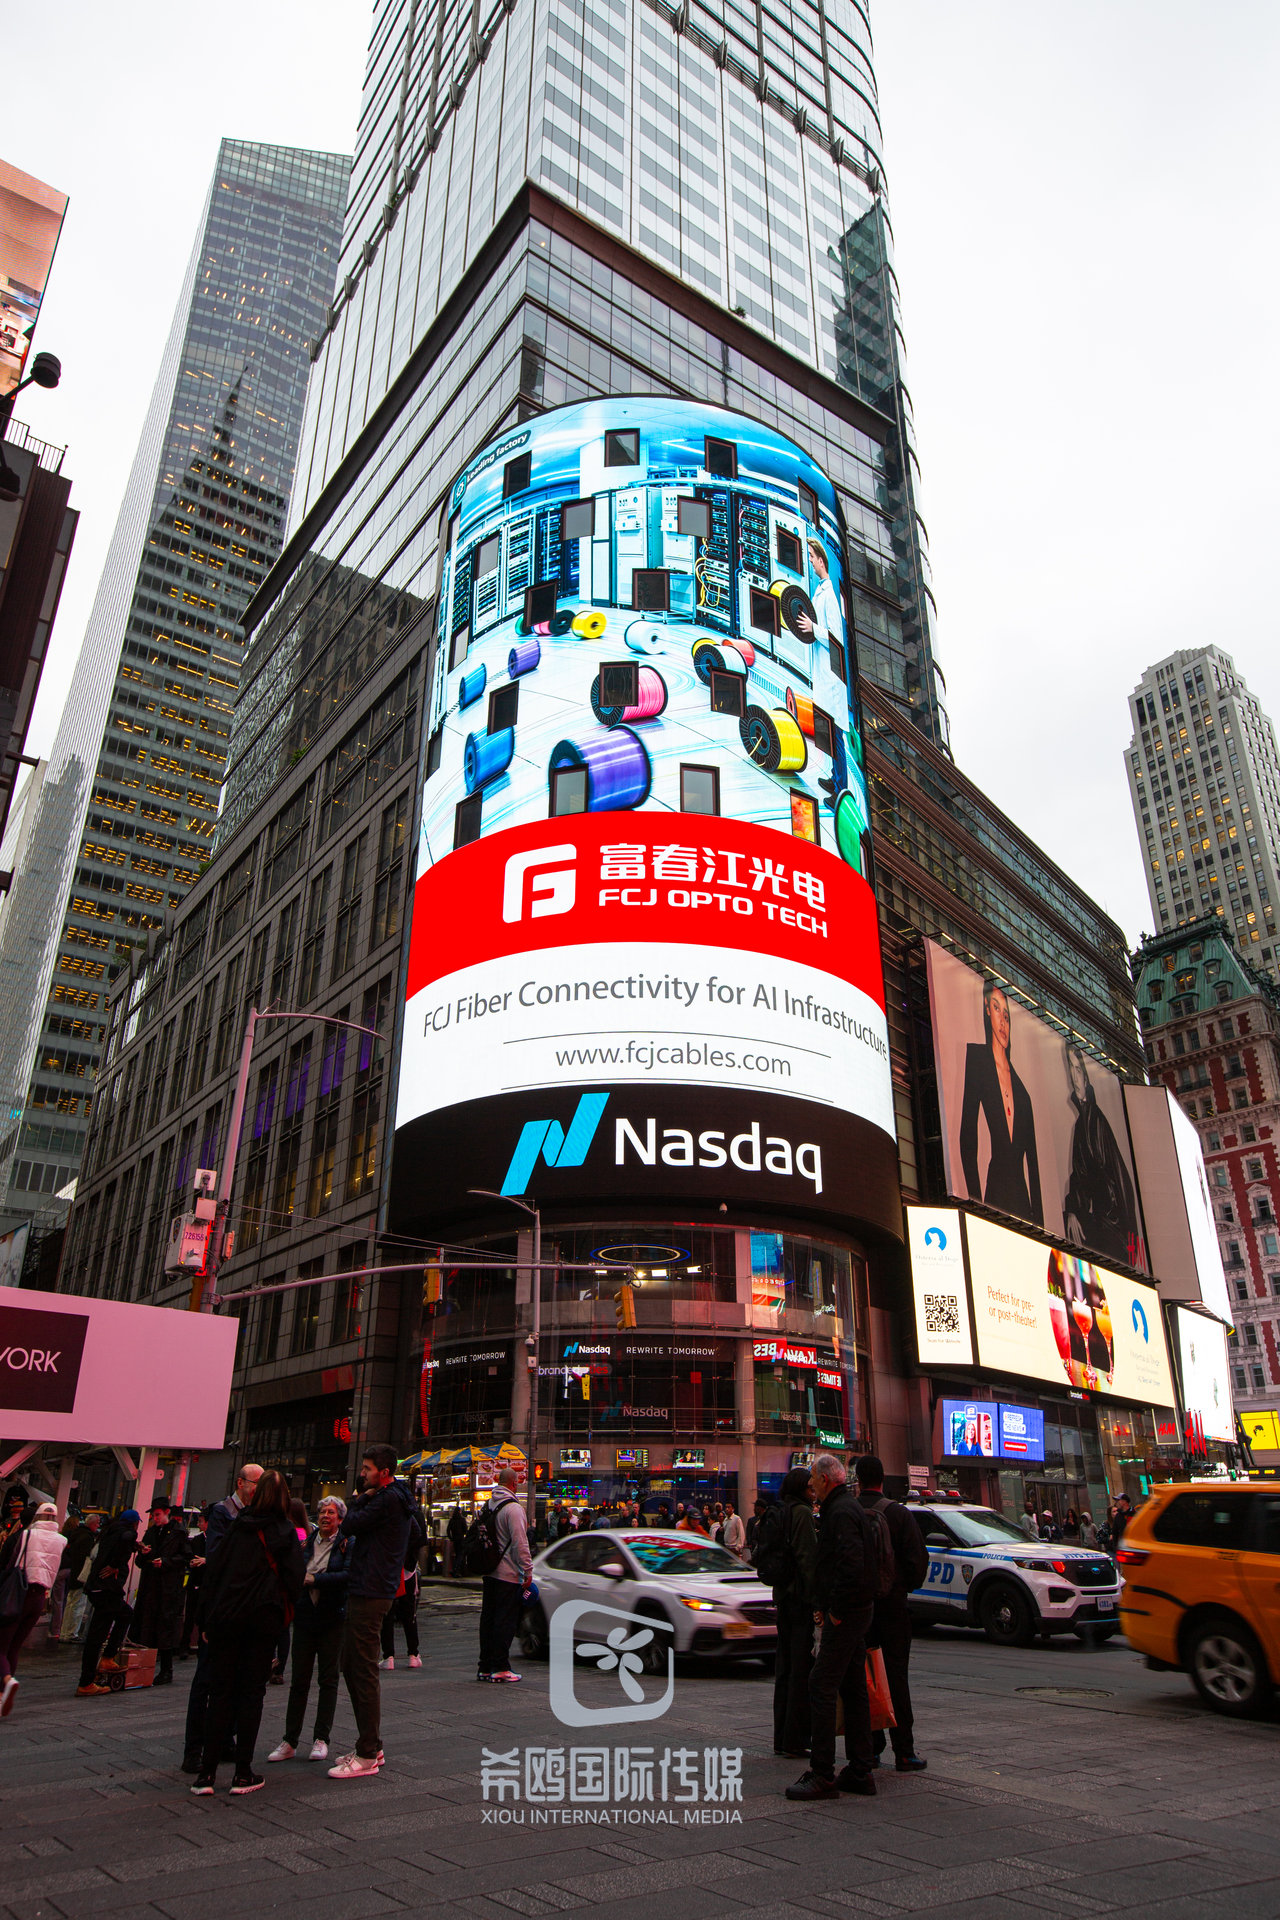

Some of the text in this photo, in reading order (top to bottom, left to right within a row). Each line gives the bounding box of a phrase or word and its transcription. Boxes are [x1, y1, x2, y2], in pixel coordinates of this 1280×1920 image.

[467, 433, 528, 481] Leading factory
[600, 843, 826, 913] 富春江光电
[598, 888, 828, 938] FCJ OPTO TECH
[423, 973, 888, 1062] FCJ Fiber Connectivity for AI Infrastructure
[555, 1040, 792, 1077] www.fcjcables.com
[615, 1117, 823, 1195] Nasdaq
[987, 1285, 1010, 1305] Perfect
[1011, 1293, 1020, 1307] for
[988, 1307, 996, 1317] or
[470, 1351, 506, 1363] TOMORROW
[578, 1344, 715, 1356] Nasdaq REWRITE TOMORROW
[623, 1405, 669, 1421] Nasdaq
[928, 1561, 955, 1585] PD
